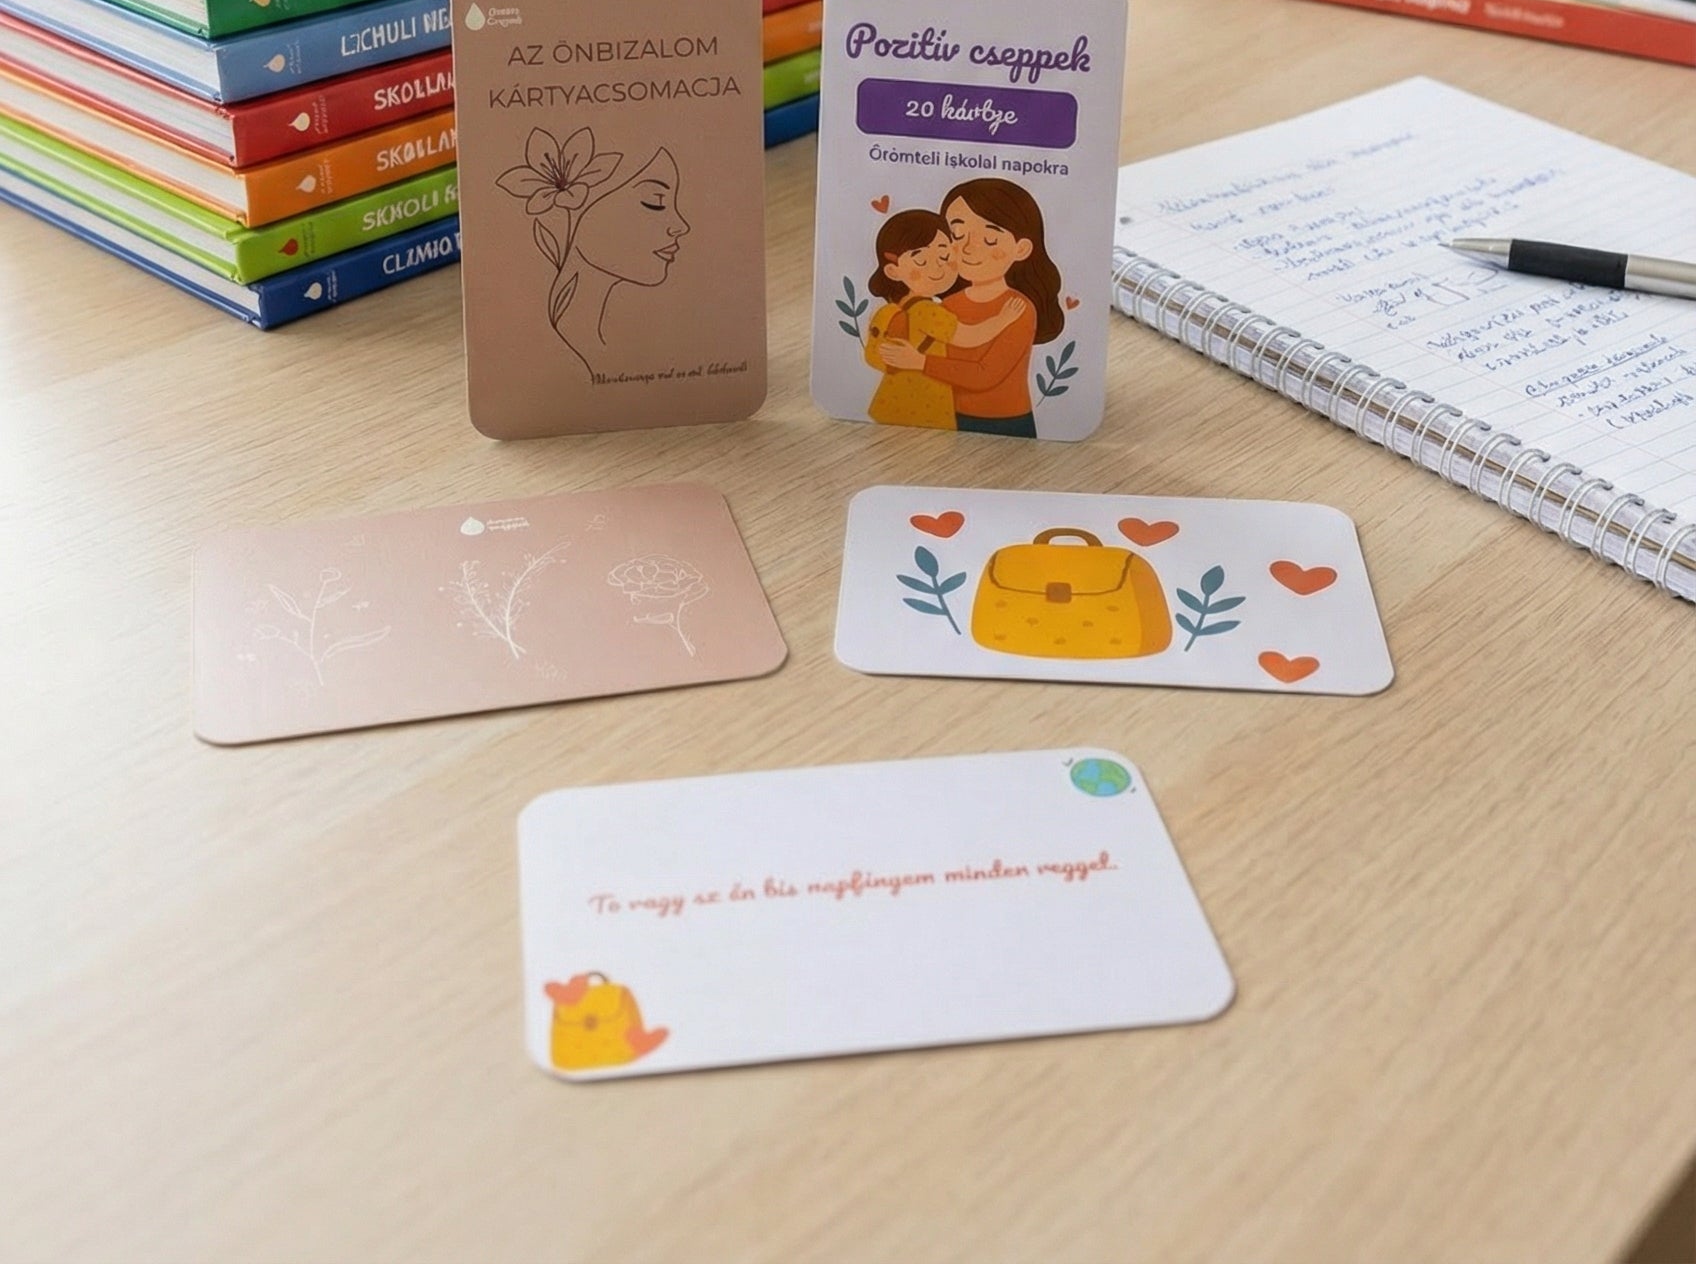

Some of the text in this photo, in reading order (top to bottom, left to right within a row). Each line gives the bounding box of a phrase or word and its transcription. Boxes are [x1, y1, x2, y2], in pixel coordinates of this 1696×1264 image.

[507, 36, 719, 67] AZ ÖNBIZALOM
[969, 35, 1091, 84] cseppek
[489, 76, 742, 109] KÁRTYACSOMACJA
[905, 100, 934, 118] 20
[1001, 159, 1069, 176] napokra
[944, 858, 1030, 884] minden
